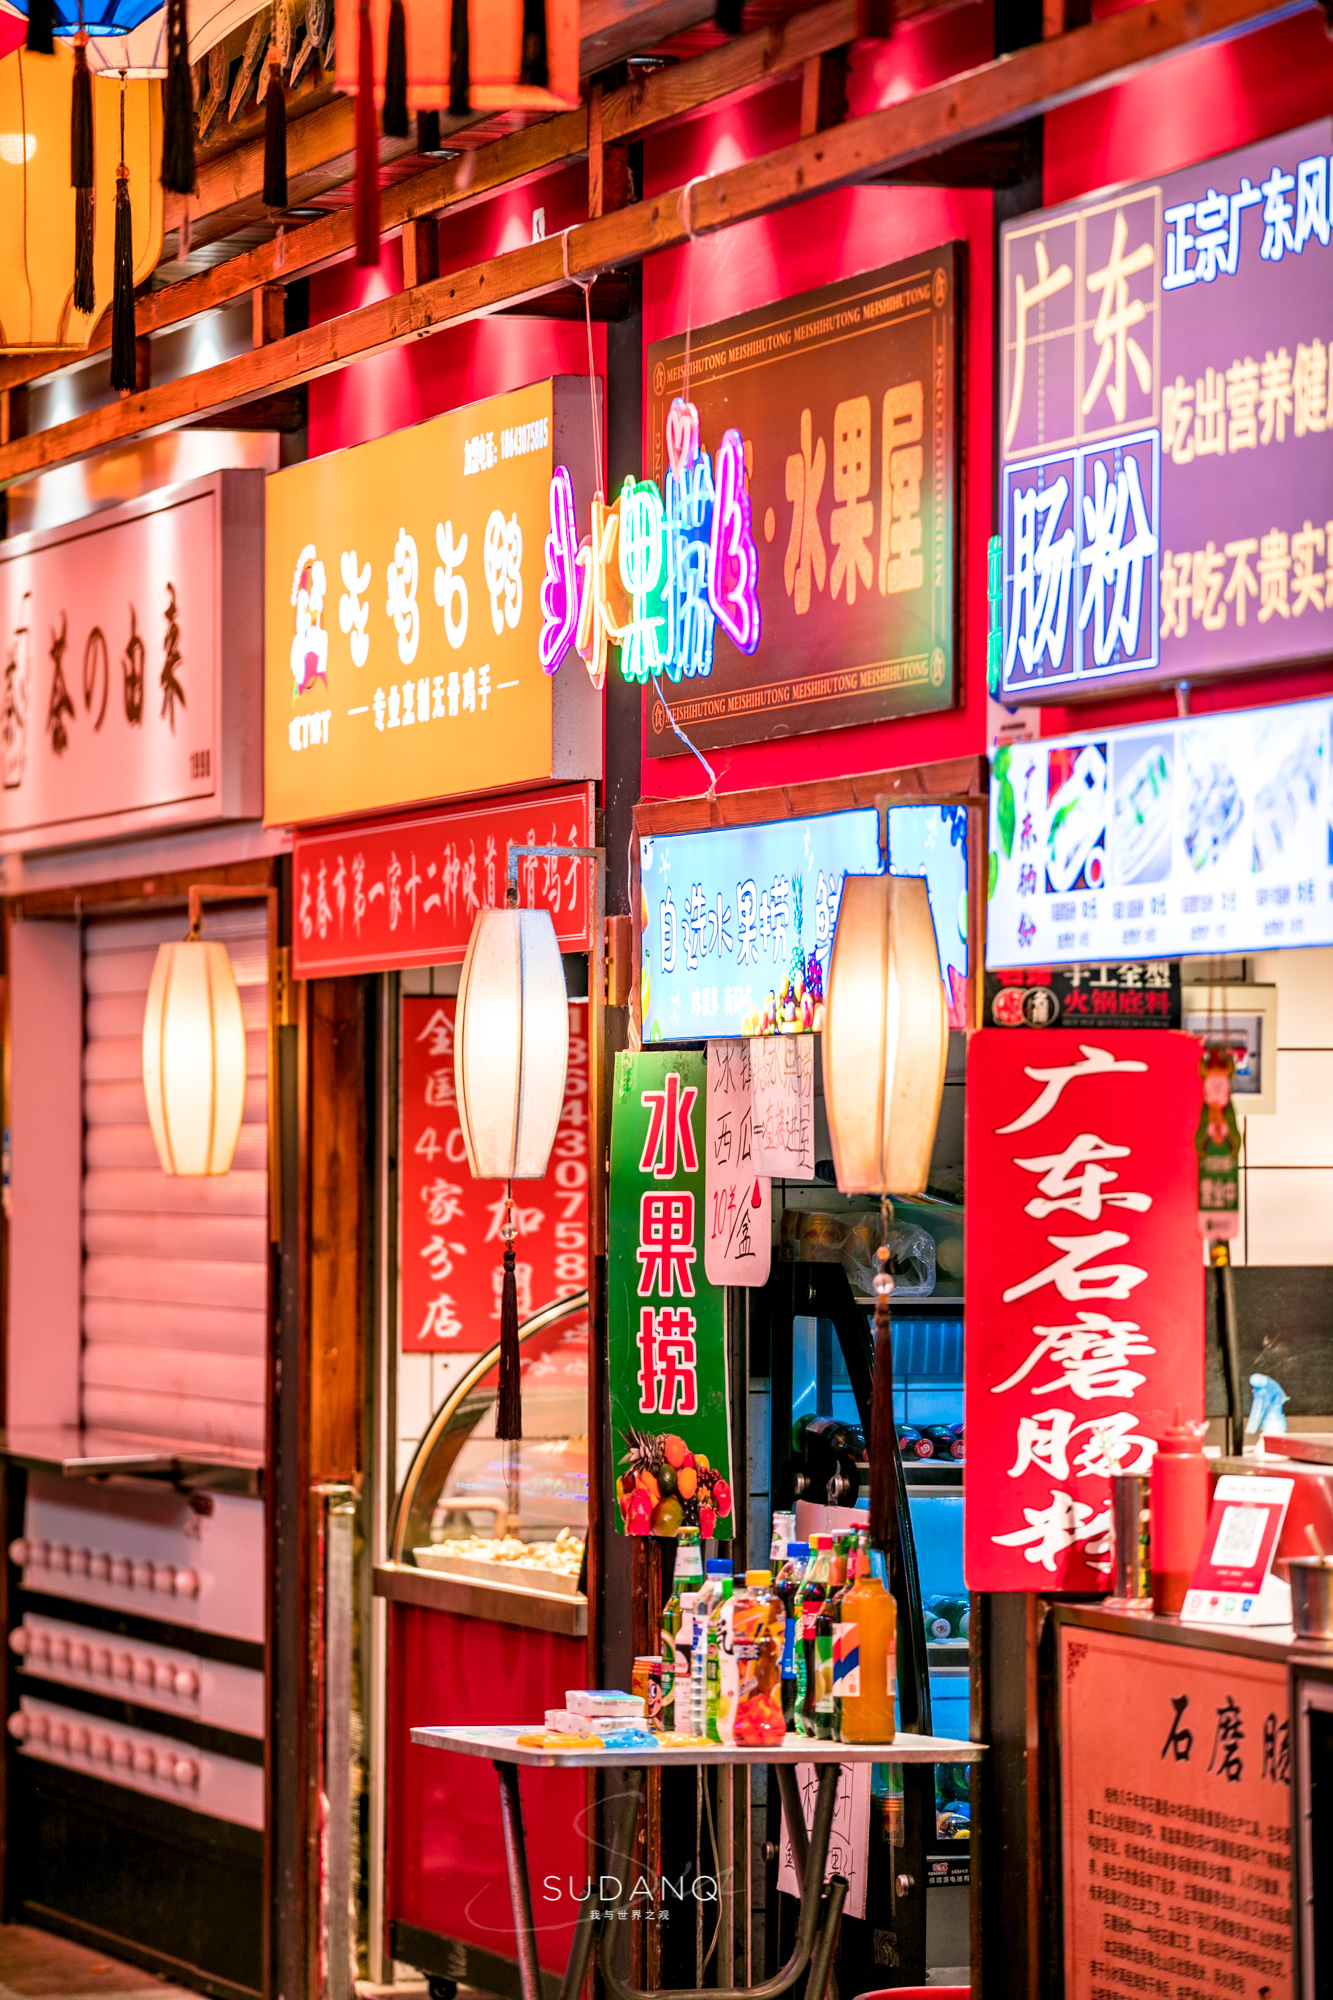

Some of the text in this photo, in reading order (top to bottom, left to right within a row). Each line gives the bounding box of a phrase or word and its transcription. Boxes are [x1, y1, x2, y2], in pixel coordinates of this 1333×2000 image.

[1162, 155, 1333, 291] 正宗广东风
[666, 283, 931, 384] MEISHIHUTONG MEISHIHUTONG MEISHIHUTONG MEISHIHUTONG
[1003, 209, 1156, 450] 广东
[1161, 337, 1333, 465] 吃出营养健
[574, 455, 717, 684] 水果捞
[1003, 455, 1158, 678] 肠粉
[1160, 520, 1333, 640] 好吃不贵实
[666, 658, 929, 724] MEISHIHUTONG MEISHIHUTONG MEISHIHUTONG MEISHIHUTONG
[659, 874, 790, 974] 自选水果捞
[1063, 988, 1171, 1016] 火锅底料
[484, 1182, 545, 1320] 加盟
[637, 1072, 700, 1416] 水果捞
